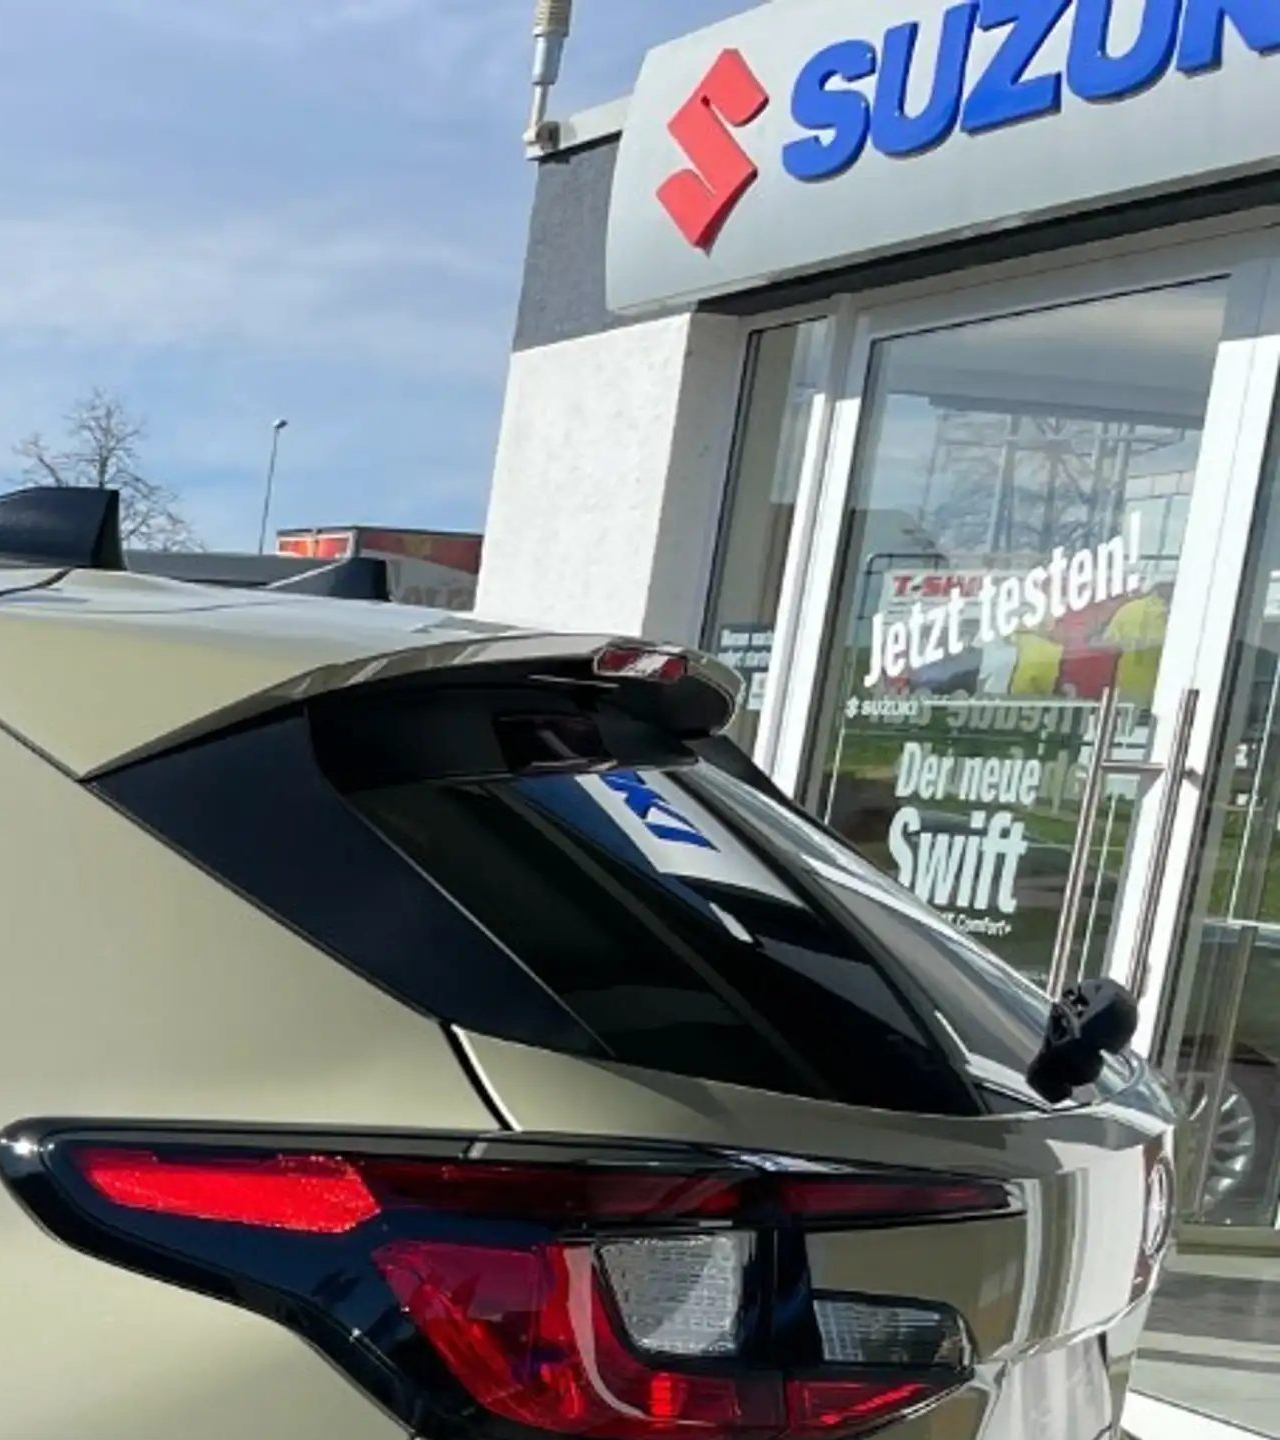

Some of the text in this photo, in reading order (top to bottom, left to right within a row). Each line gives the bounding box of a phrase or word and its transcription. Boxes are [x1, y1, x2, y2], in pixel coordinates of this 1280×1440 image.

[863, 510, 1141, 688] Jetzt testen!
[894, 741, 955, 801] Der
[958, 756, 1041, 806] neue
[887, 806, 1029, 914] Swift
